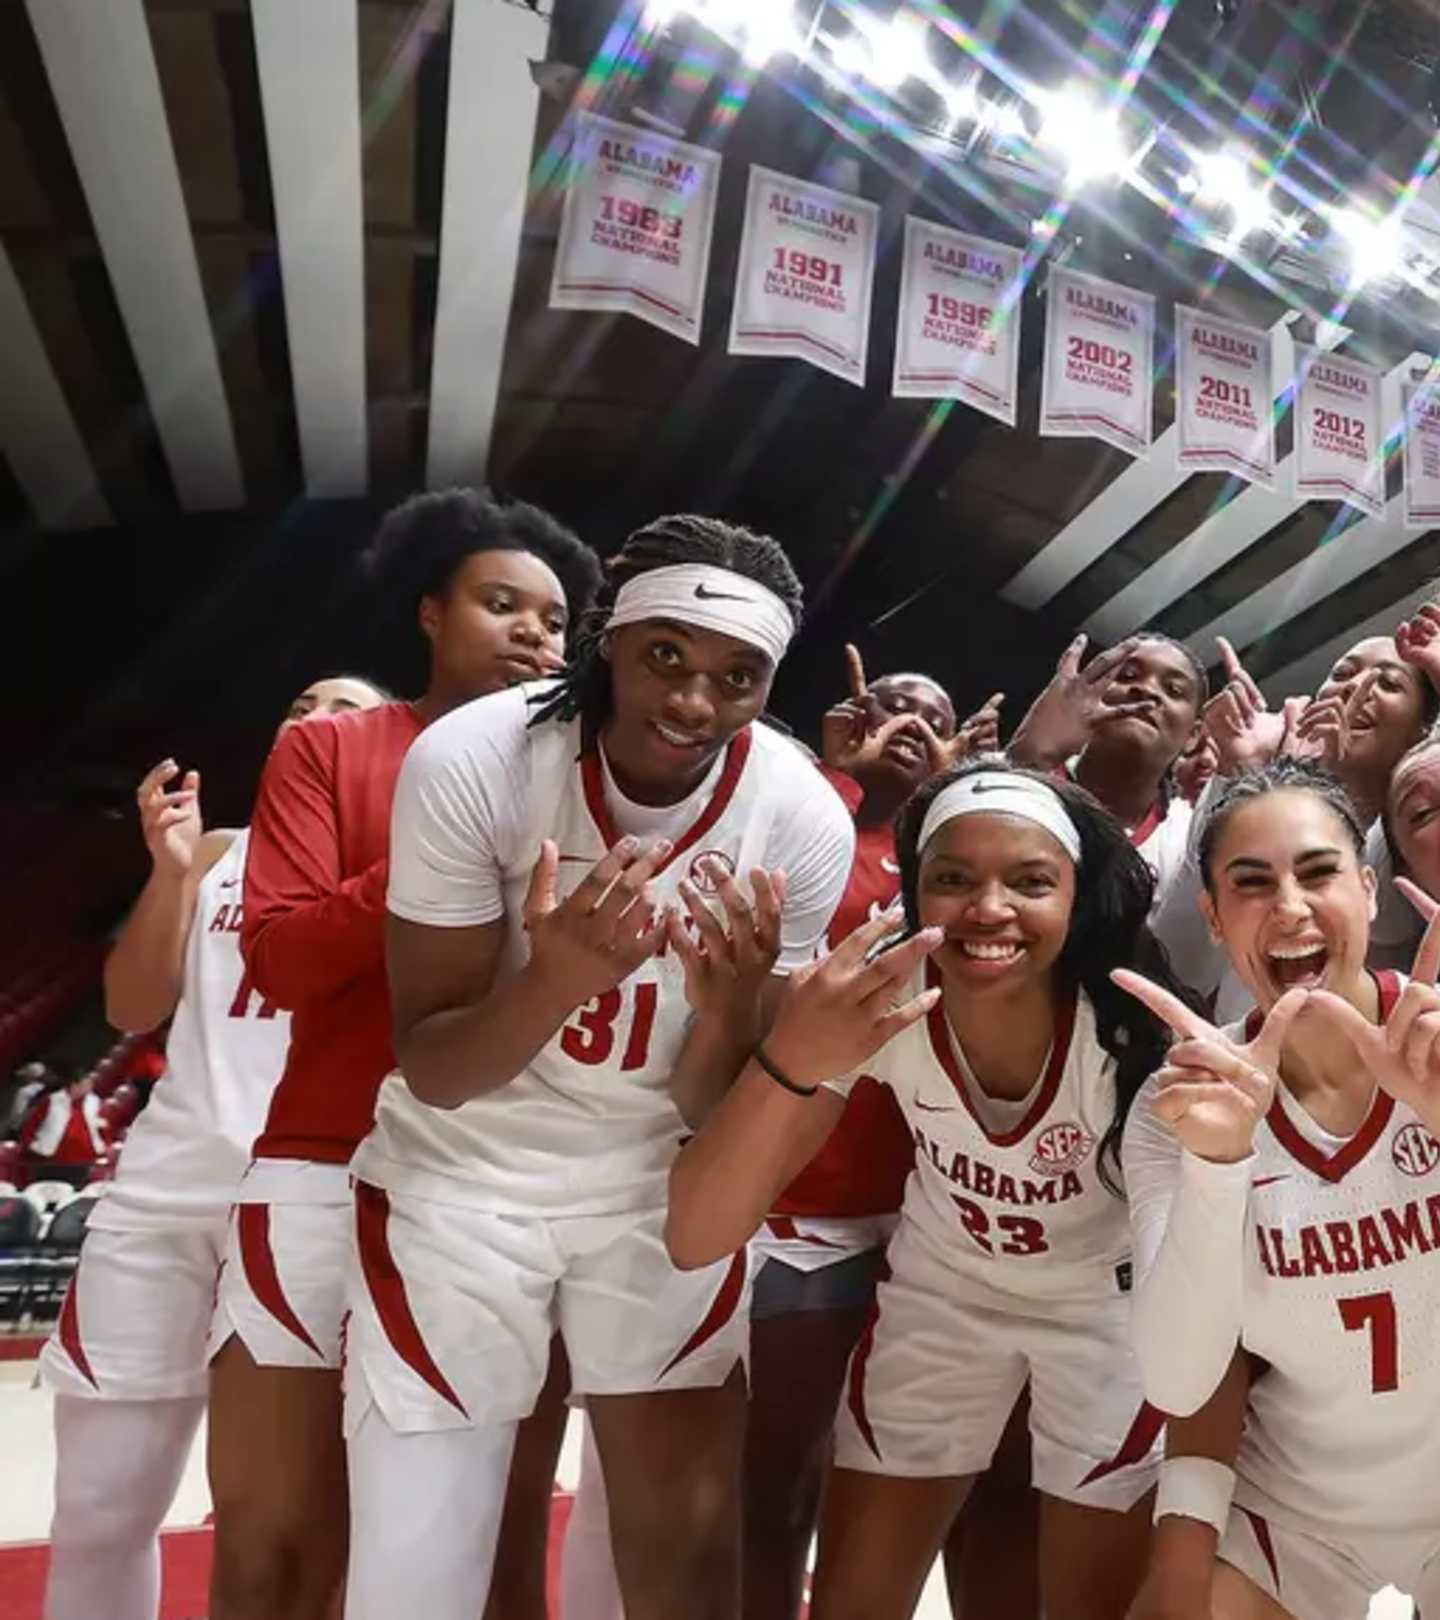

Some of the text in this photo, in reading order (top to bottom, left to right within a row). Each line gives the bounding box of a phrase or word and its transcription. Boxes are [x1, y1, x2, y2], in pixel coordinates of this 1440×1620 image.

[599, 140, 697, 185] ALABAMA
[768, 193, 857, 235] ALABAMA
[774, 247, 842, 287] 1991
[924, 241, 1004, 281] ALABAMA
[765, 269, 846, 302] NATIONAL
[1066, 287, 1137, 325] ALABAMA
[1067, 336, 1132, 373] 2002
[1192, 328, 1258, 361] ALABAMA
[1200, 376, 1252, 408] 2011
[1313, 408, 1365, 441] 2012
[560, 982, 658, 1072] 31
[1038, 1126, 1084, 1162] SEC
[1394, 1126, 1440, 1174] SEC
[951, 1192, 1050, 1256] 23
[1338, 1291, 1399, 1395] 7
